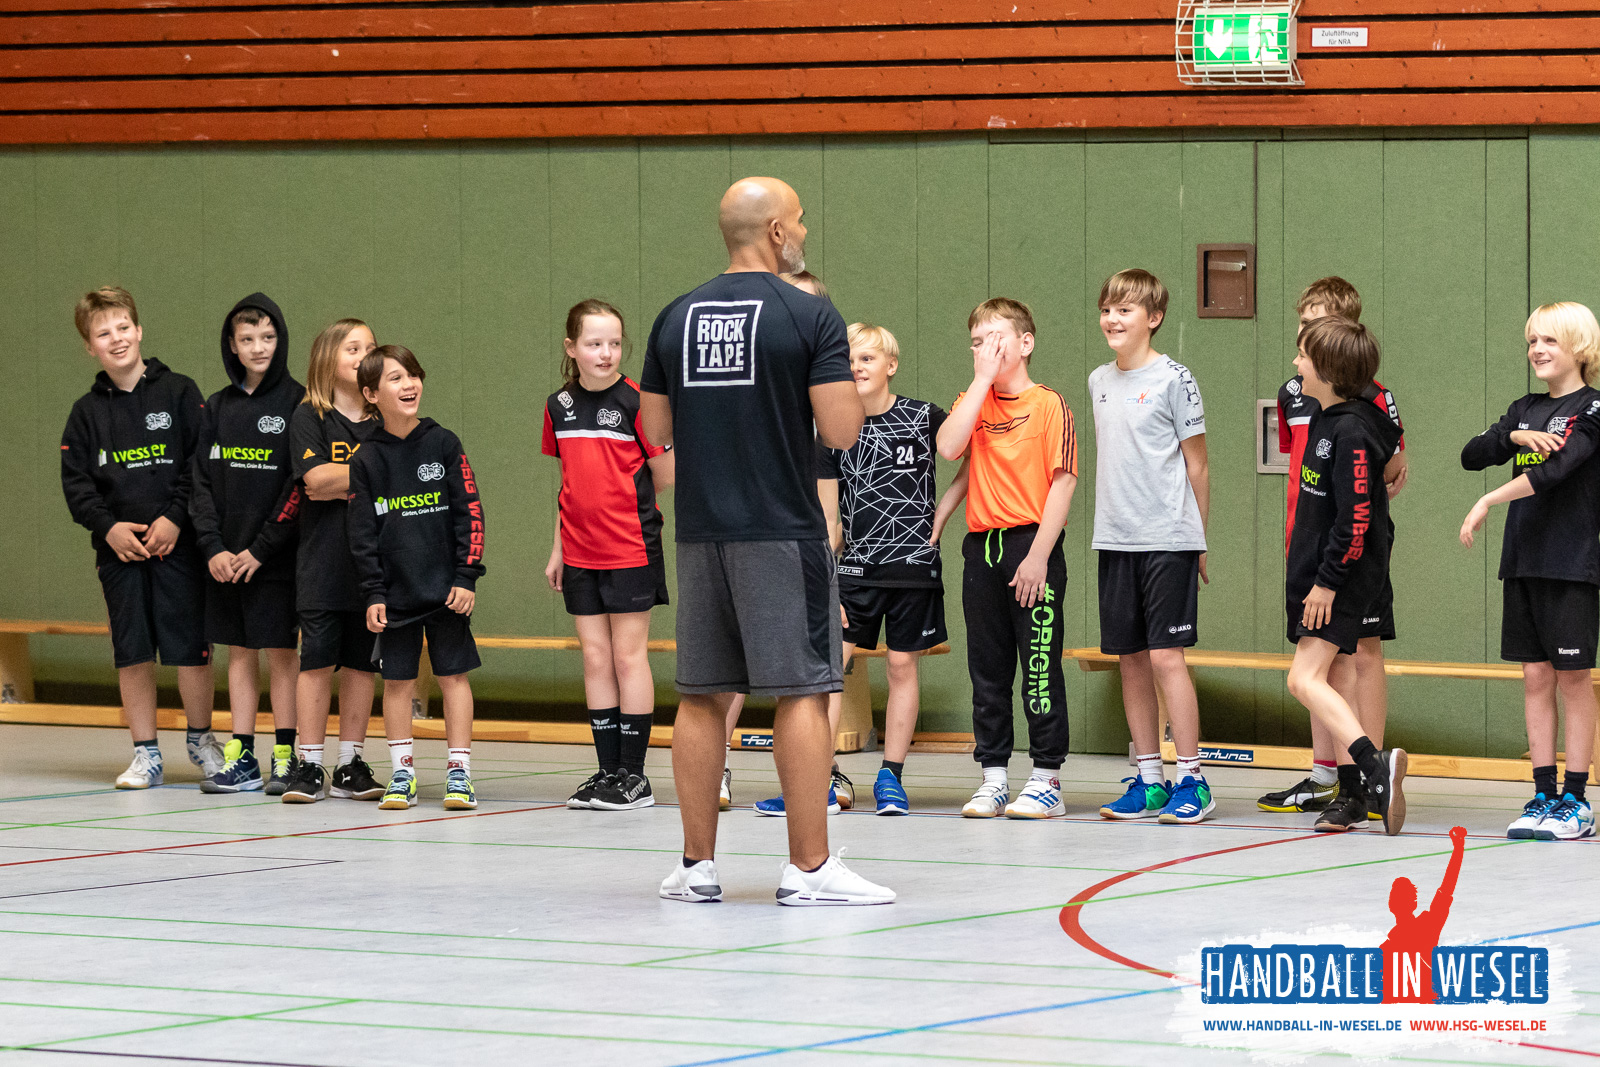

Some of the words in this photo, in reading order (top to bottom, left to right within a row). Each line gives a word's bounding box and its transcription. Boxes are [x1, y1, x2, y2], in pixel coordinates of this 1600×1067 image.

[697, 318, 747, 343] ROCK
[697, 342, 745, 368] TAPE
[222, 446, 273, 461] wesser
[896, 445, 914, 465] 24
[460, 454, 477, 494] HSG
[1353, 449, 1368, 494] HSG
[388, 491, 441, 511] wesser
[467, 500, 485, 565] WESEL
[1341, 500, 1371, 564] WESEL
[742, 735, 774, 746] for
